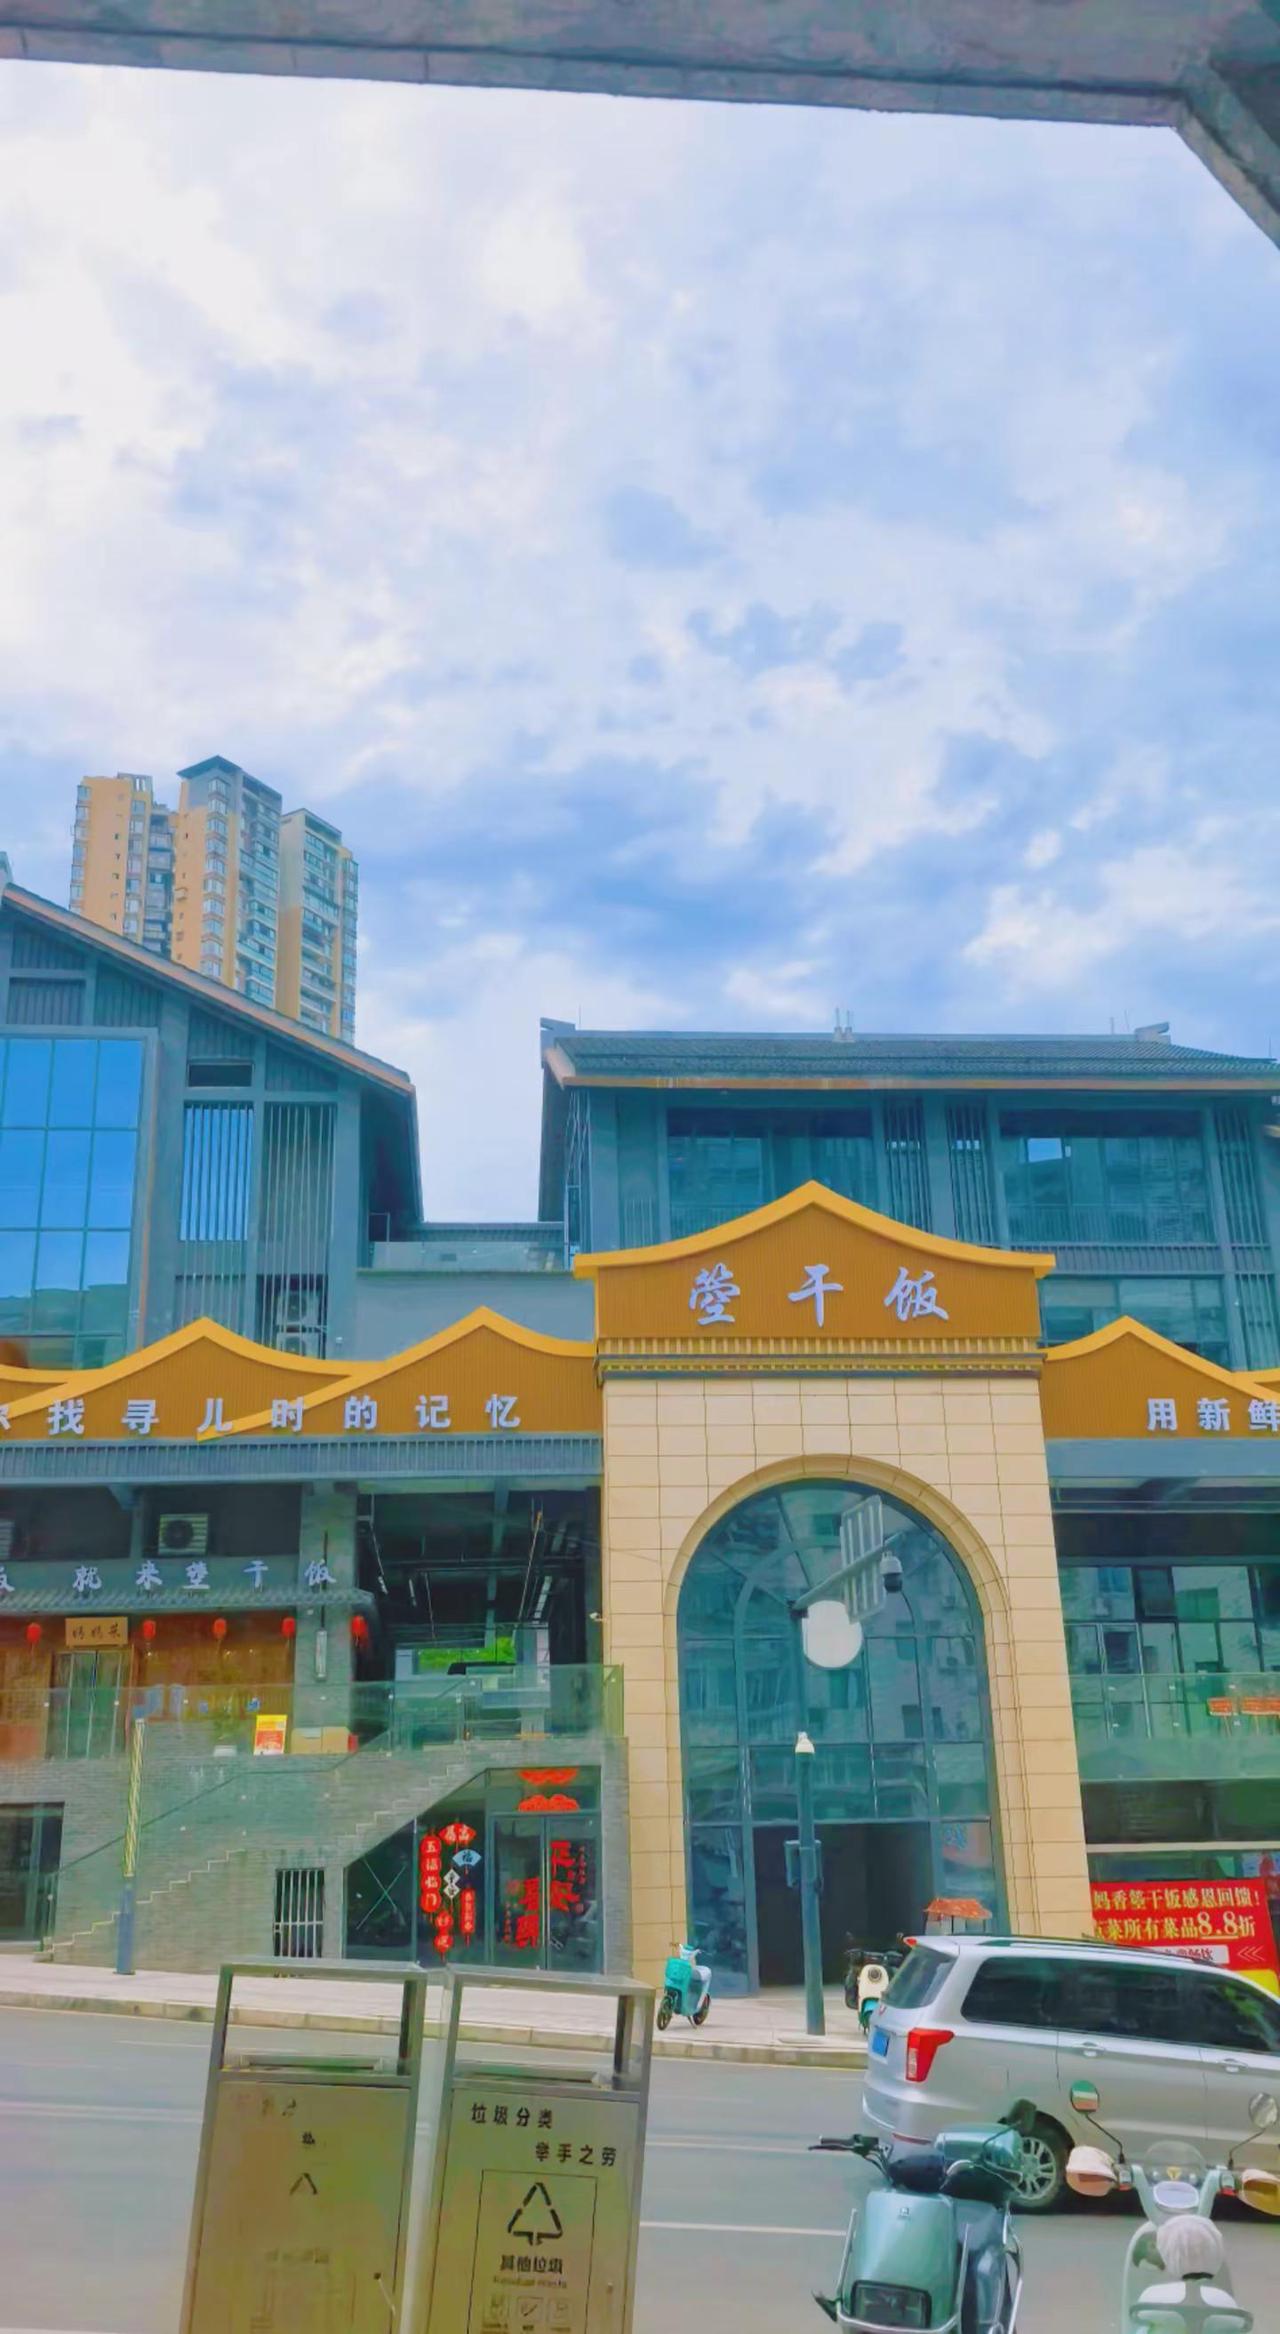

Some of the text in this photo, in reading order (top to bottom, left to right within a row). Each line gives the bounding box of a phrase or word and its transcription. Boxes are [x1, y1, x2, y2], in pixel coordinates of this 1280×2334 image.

[1147, 1398, 1280, 1432] 用新鲜
[471, 2103, 553, 2129] 垃圾分类
[535, 2141, 616, 2167] 举手之劳
